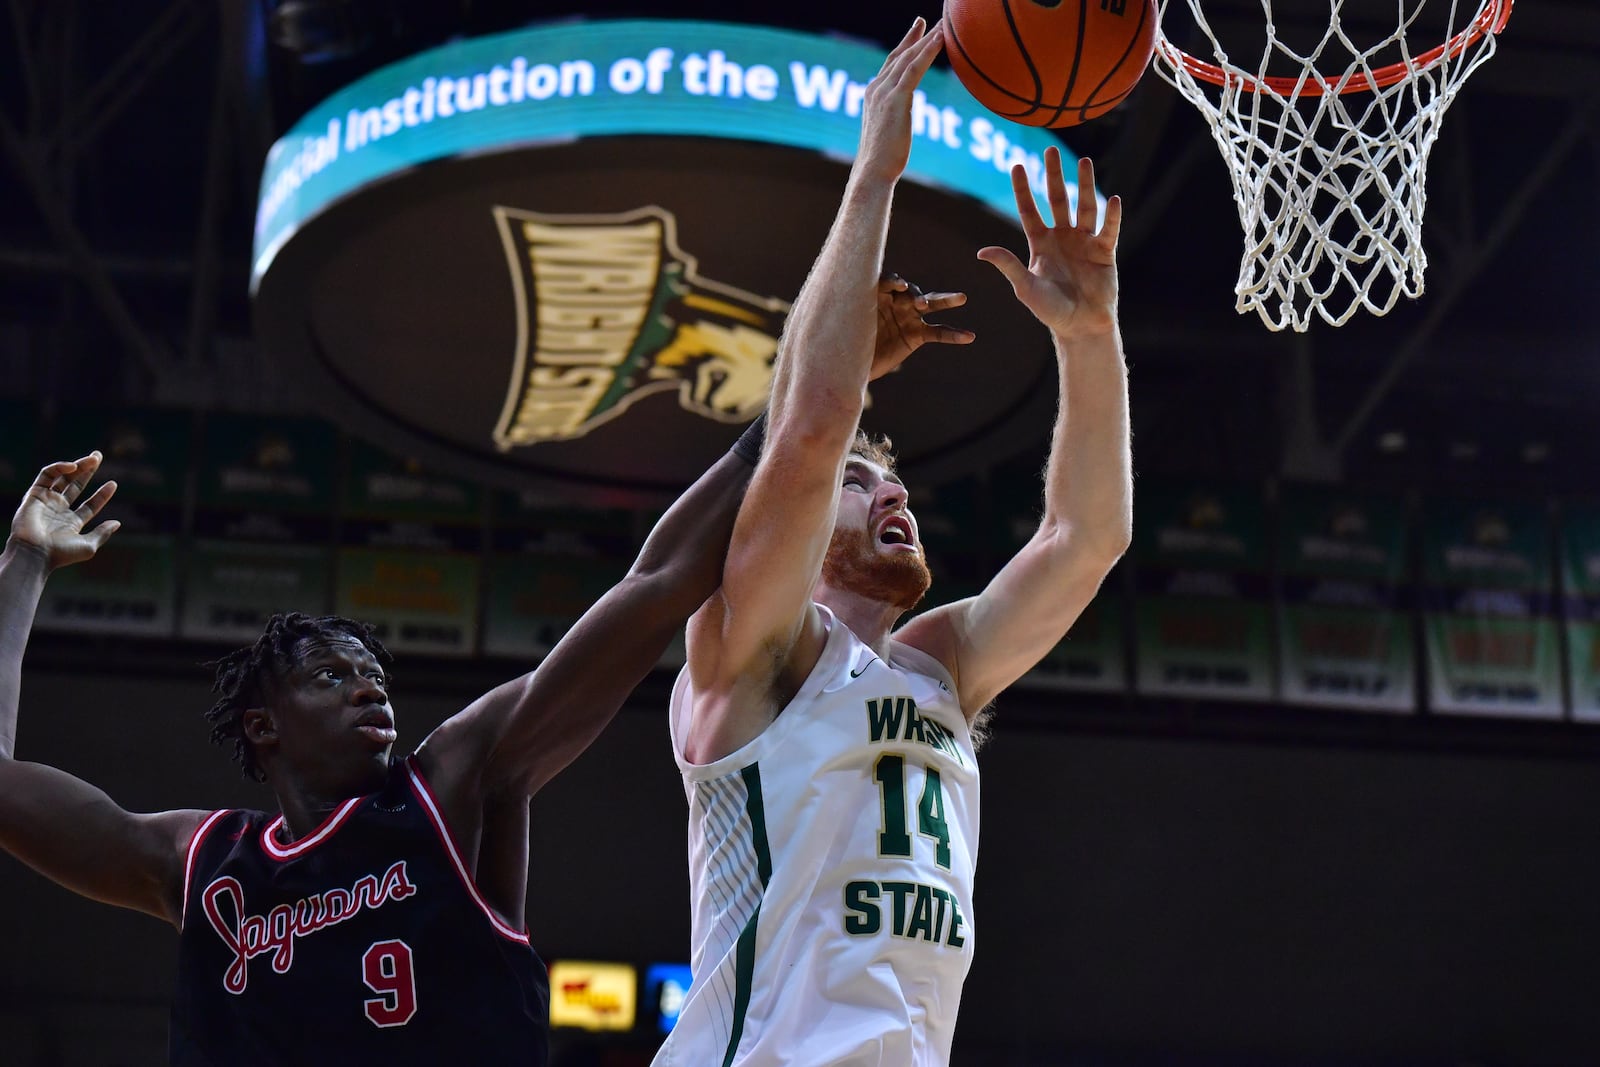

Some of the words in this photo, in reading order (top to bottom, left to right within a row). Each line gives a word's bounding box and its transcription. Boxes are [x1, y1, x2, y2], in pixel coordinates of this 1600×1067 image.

[346, 57, 594, 150] Institution
[608, 46, 674, 95] of
[681, 48, 779, 101] the
[790, 61, 962, 148] Wrht
[970, 117, 1056, 203] Stat
[522, 220, 662, 367] WRIGHT
[865, 695, 965, 767] WRHT
[872, 751, 952, 873] 14
[201, 860, 417, 995] Jaguars
[842, 879, 966, 948] STATE
[361, 937, 418, 1029] 9
